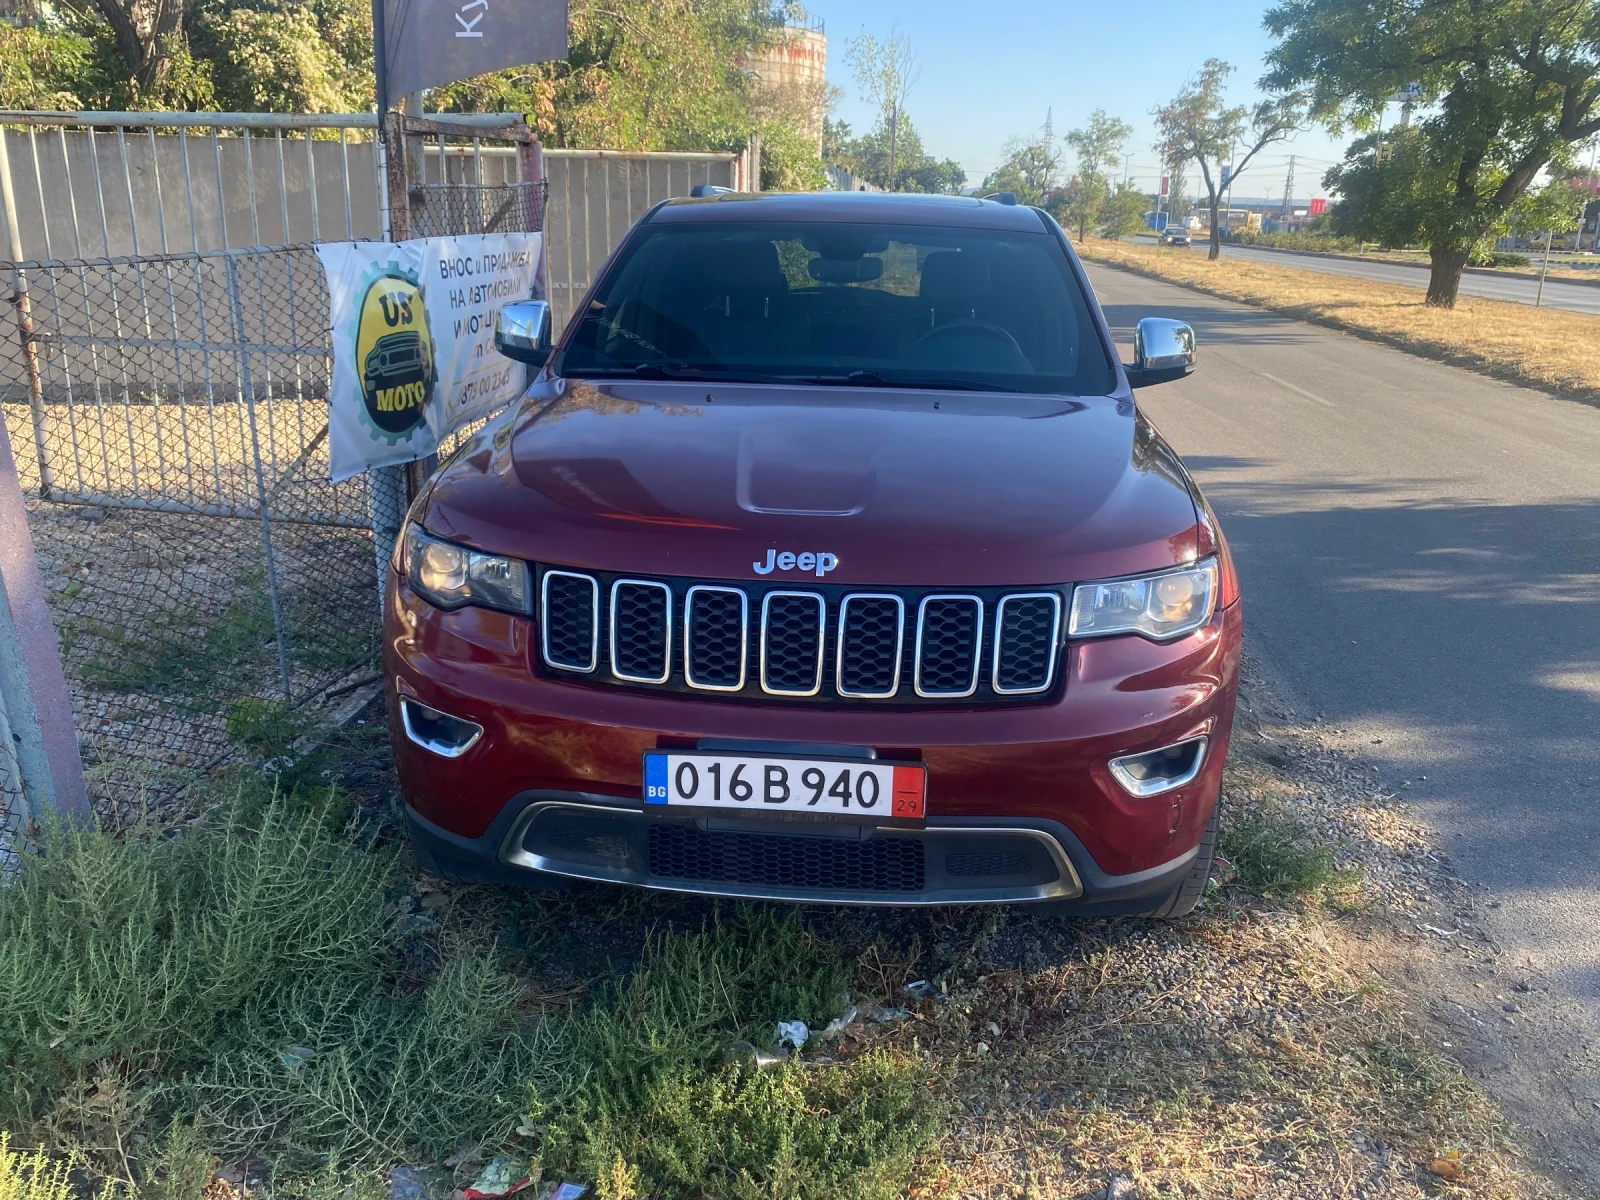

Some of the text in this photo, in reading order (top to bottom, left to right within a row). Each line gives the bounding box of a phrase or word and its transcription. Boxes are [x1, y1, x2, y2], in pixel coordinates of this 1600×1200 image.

[439, 257, 474, 279] ВНОС
[378, 291, 413, 327] US
[449, 288, 466, 309] НА
[375, 380, 426, 412] MOTO
[479, 376, 491, 396] 00
[752, 548, 838, 577] Jeep
[648, 761, 880, 809] BG 016 B 940
[897, 799, 917, 813] 29
